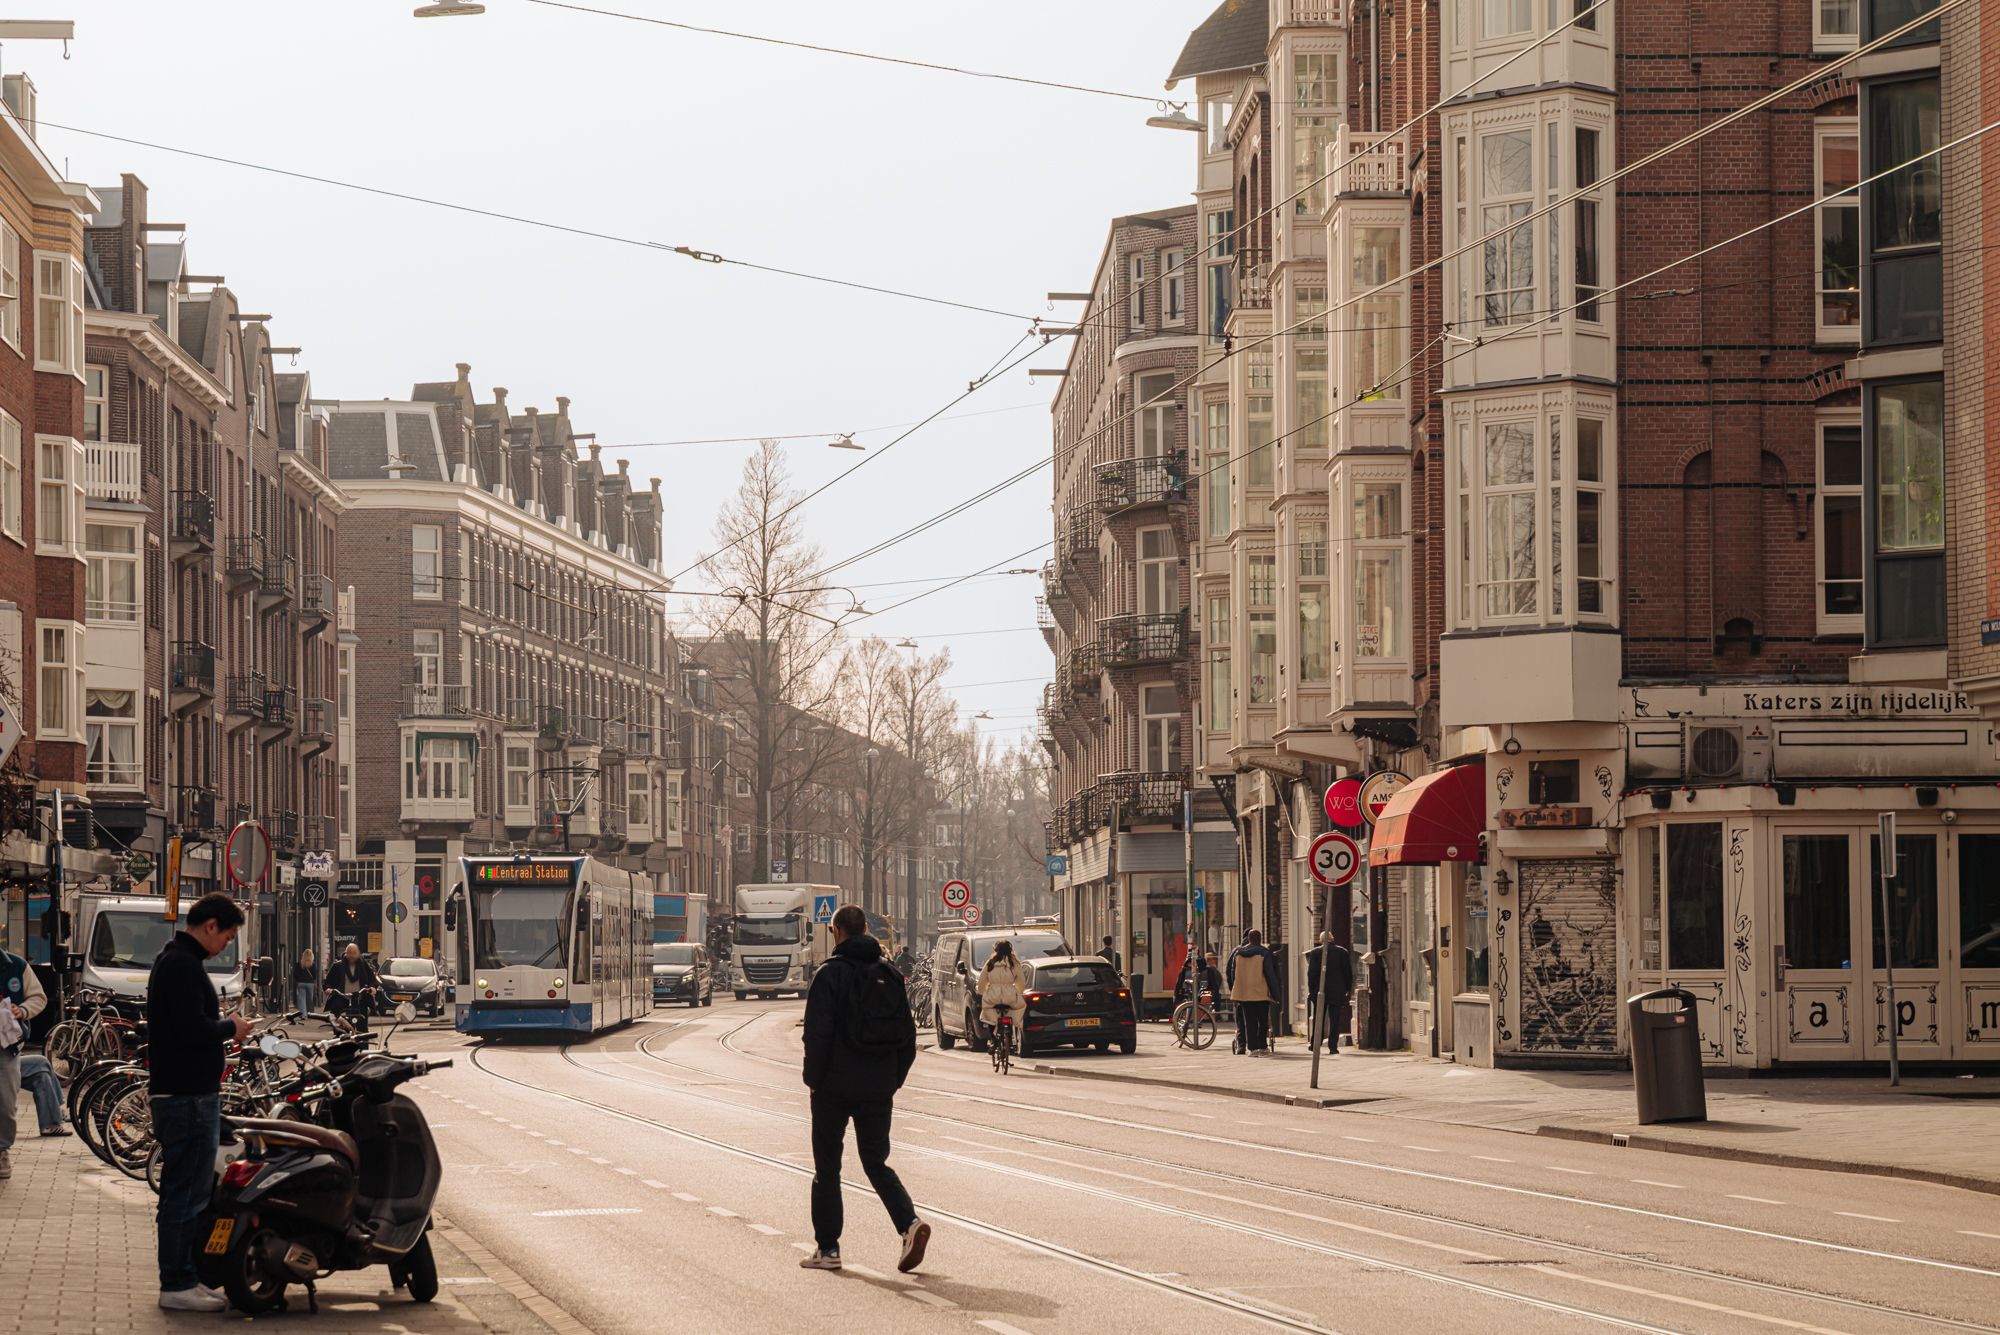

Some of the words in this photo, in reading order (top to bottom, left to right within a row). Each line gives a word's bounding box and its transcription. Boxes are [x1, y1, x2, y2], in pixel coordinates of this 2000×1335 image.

[1743, 693, 1822, 710] Katers
[1830, 693, 1872, 714] zijn
[1318, 850, 1351, 870] 30
[479, 865, 486, 878] 4
[496, 864, 533, 878] Centraal
[535, 864, 568, 878] Station
[947, 889, 966, 900] 30
[966, 910, 977, 918] 30
